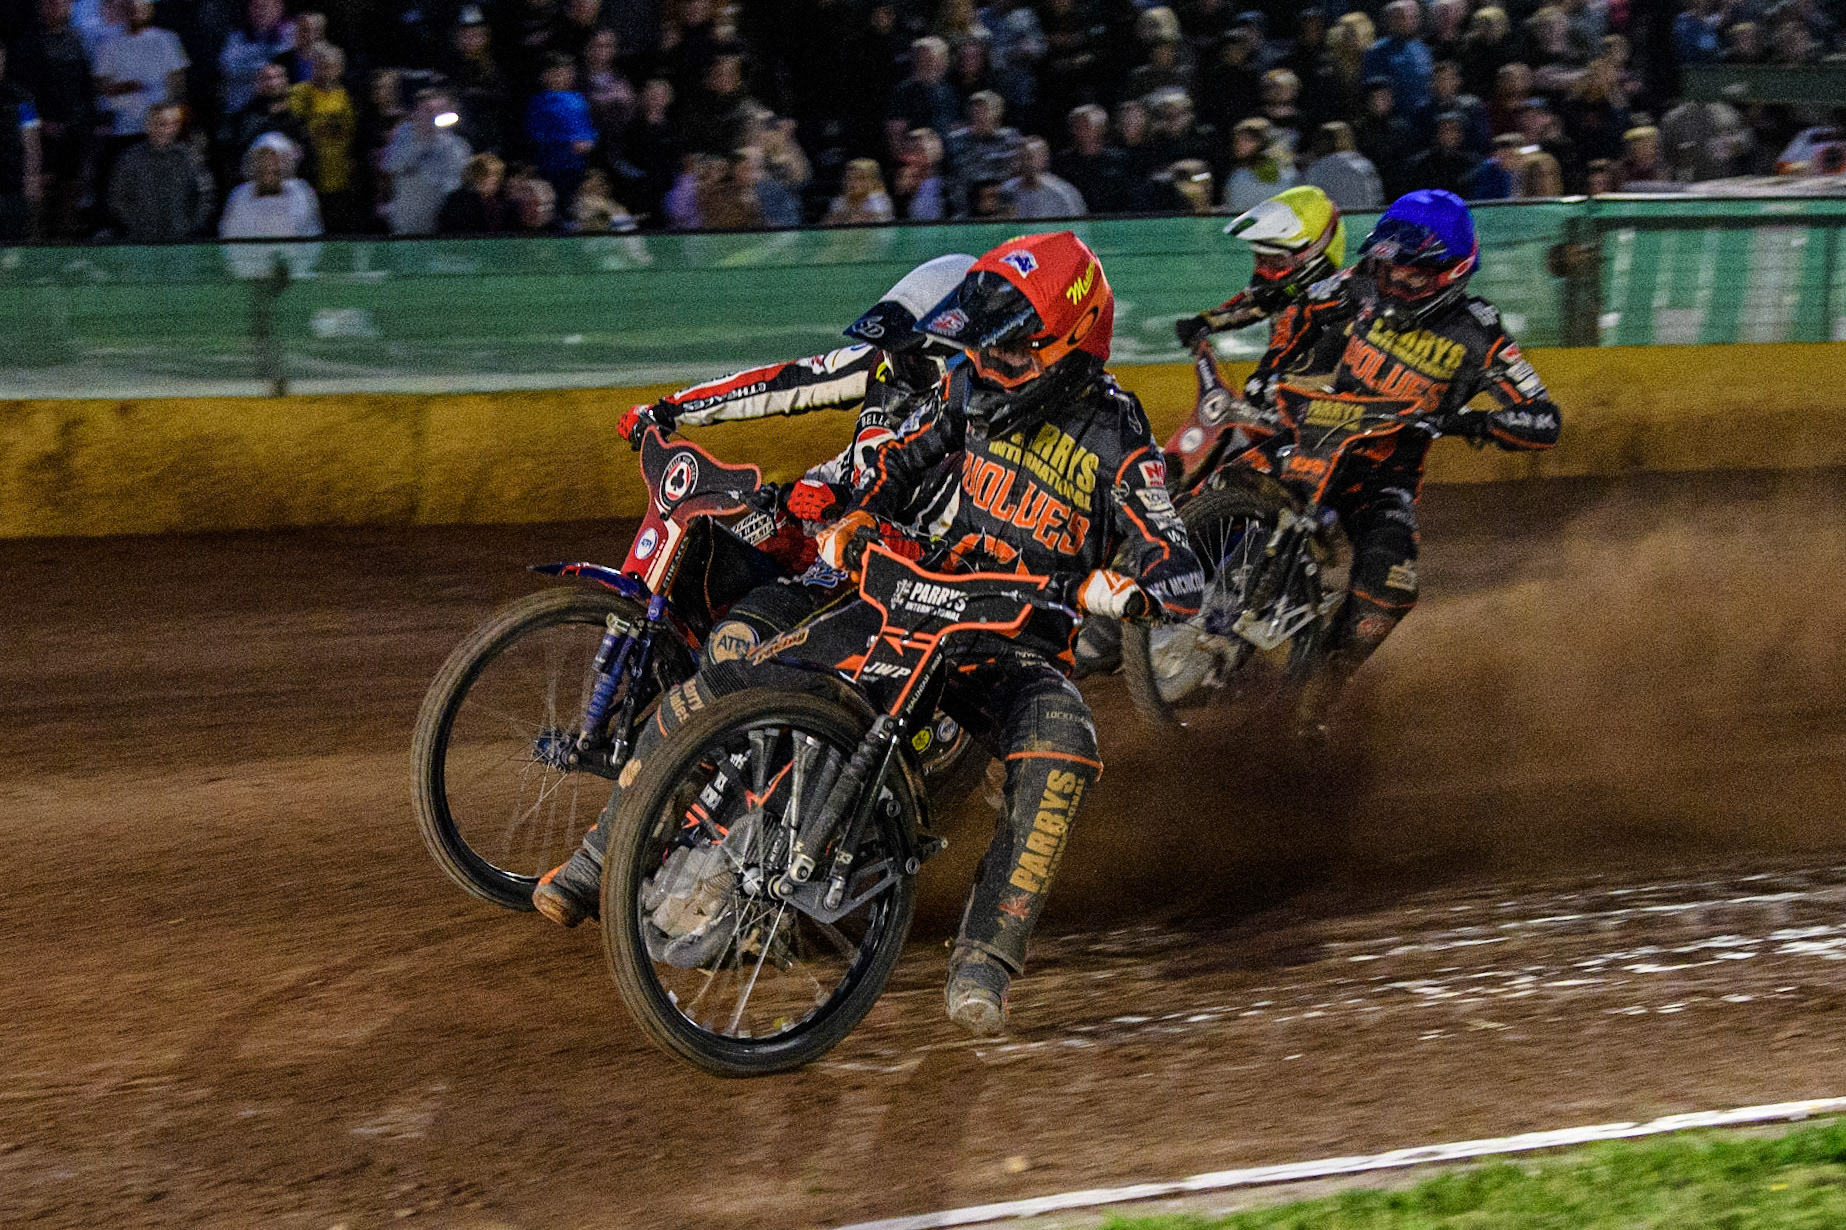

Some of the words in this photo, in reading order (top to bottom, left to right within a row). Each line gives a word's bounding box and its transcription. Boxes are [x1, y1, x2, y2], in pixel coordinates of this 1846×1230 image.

[909, 582, 969, 613] PARRYS
[863, 661, 912, 679] JWP
[1009, 768, 1077, 894] PARRYS
